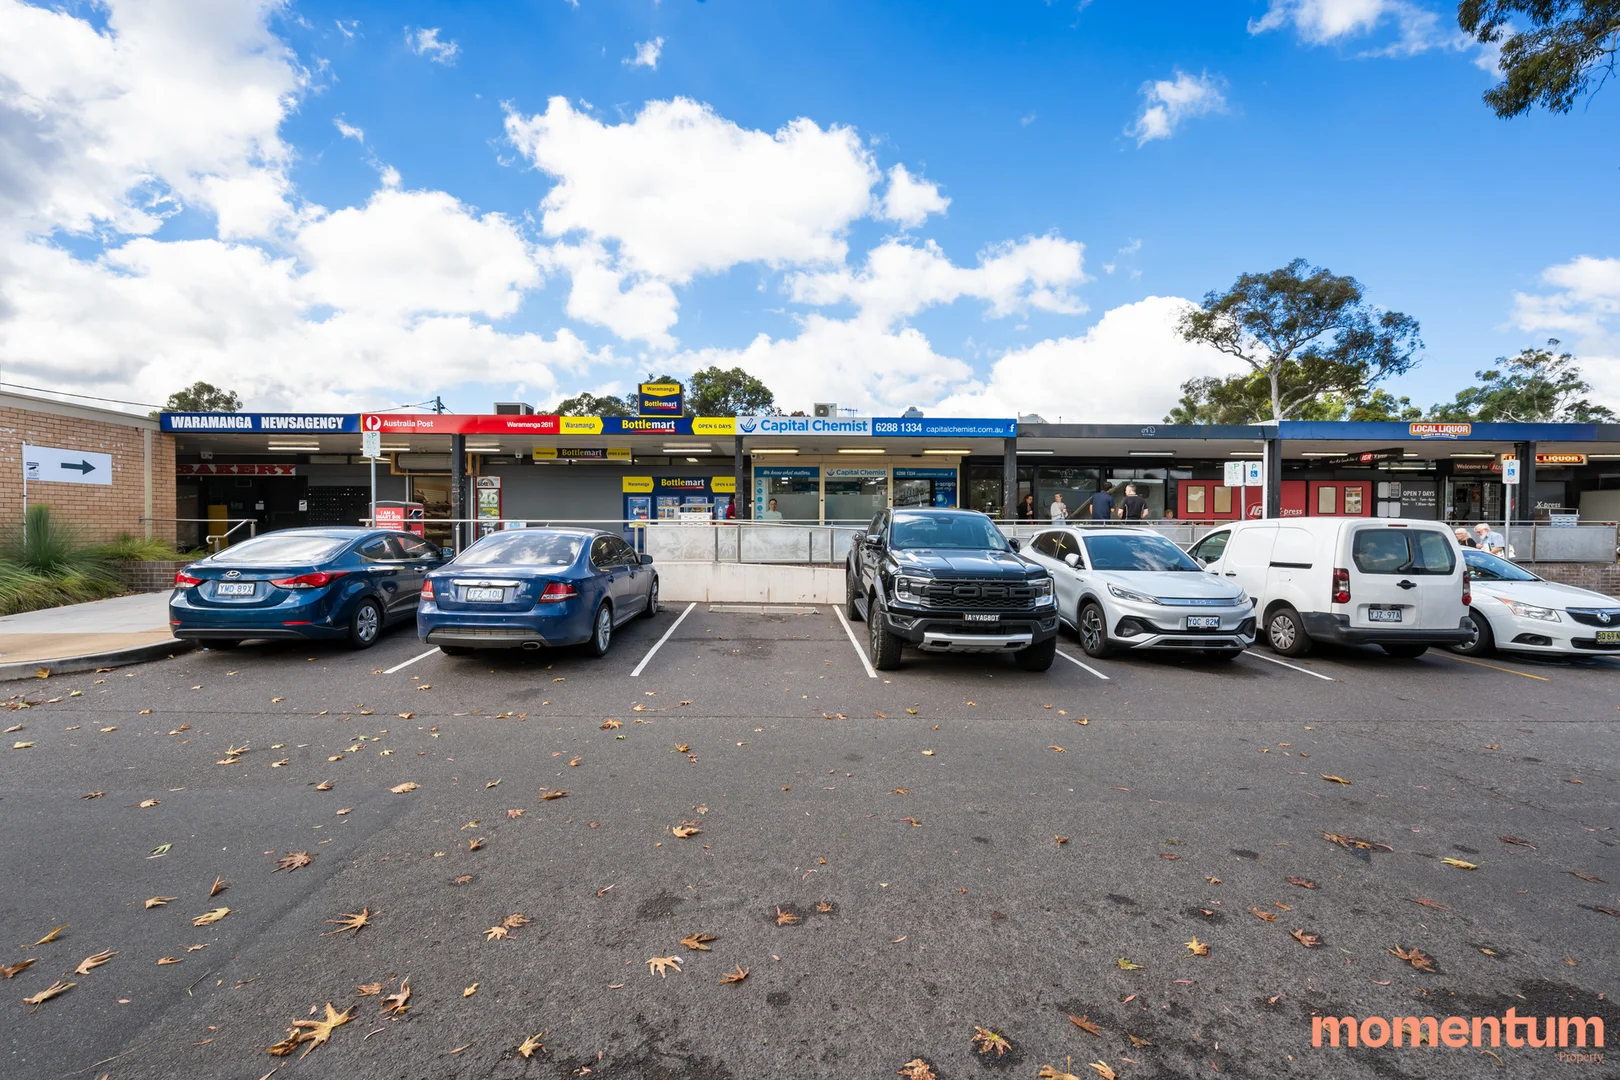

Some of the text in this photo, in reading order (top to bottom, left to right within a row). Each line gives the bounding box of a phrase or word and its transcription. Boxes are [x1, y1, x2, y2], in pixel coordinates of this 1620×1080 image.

[171, 416, 344, 429] WARAMANGA NEWSAGENCY
[383, 419, 434, 428] Australia Post
[507, 421, 541, 429] Waramanga
[565, 422, 596, 430] Waramanga
[622, 419, 676, 429] Bottlemart
[760, 419, 868, 433] Capital Chemist
[875, 422, 1004, 434] 6288 1334 capitalchemist.com.au
[1412, 425, 1469, 433] LOCAL LIQUOR
[561, 448, 602, 456] Bottlemart
[1361, 453, 1372, 461] IGA
[176, 464, 296, 475] BAKERY
[836, 469, 859, 477] Capital
[661, 478, 705, 487] Bottlemart
[928, 585, 1038, 598] FORD
